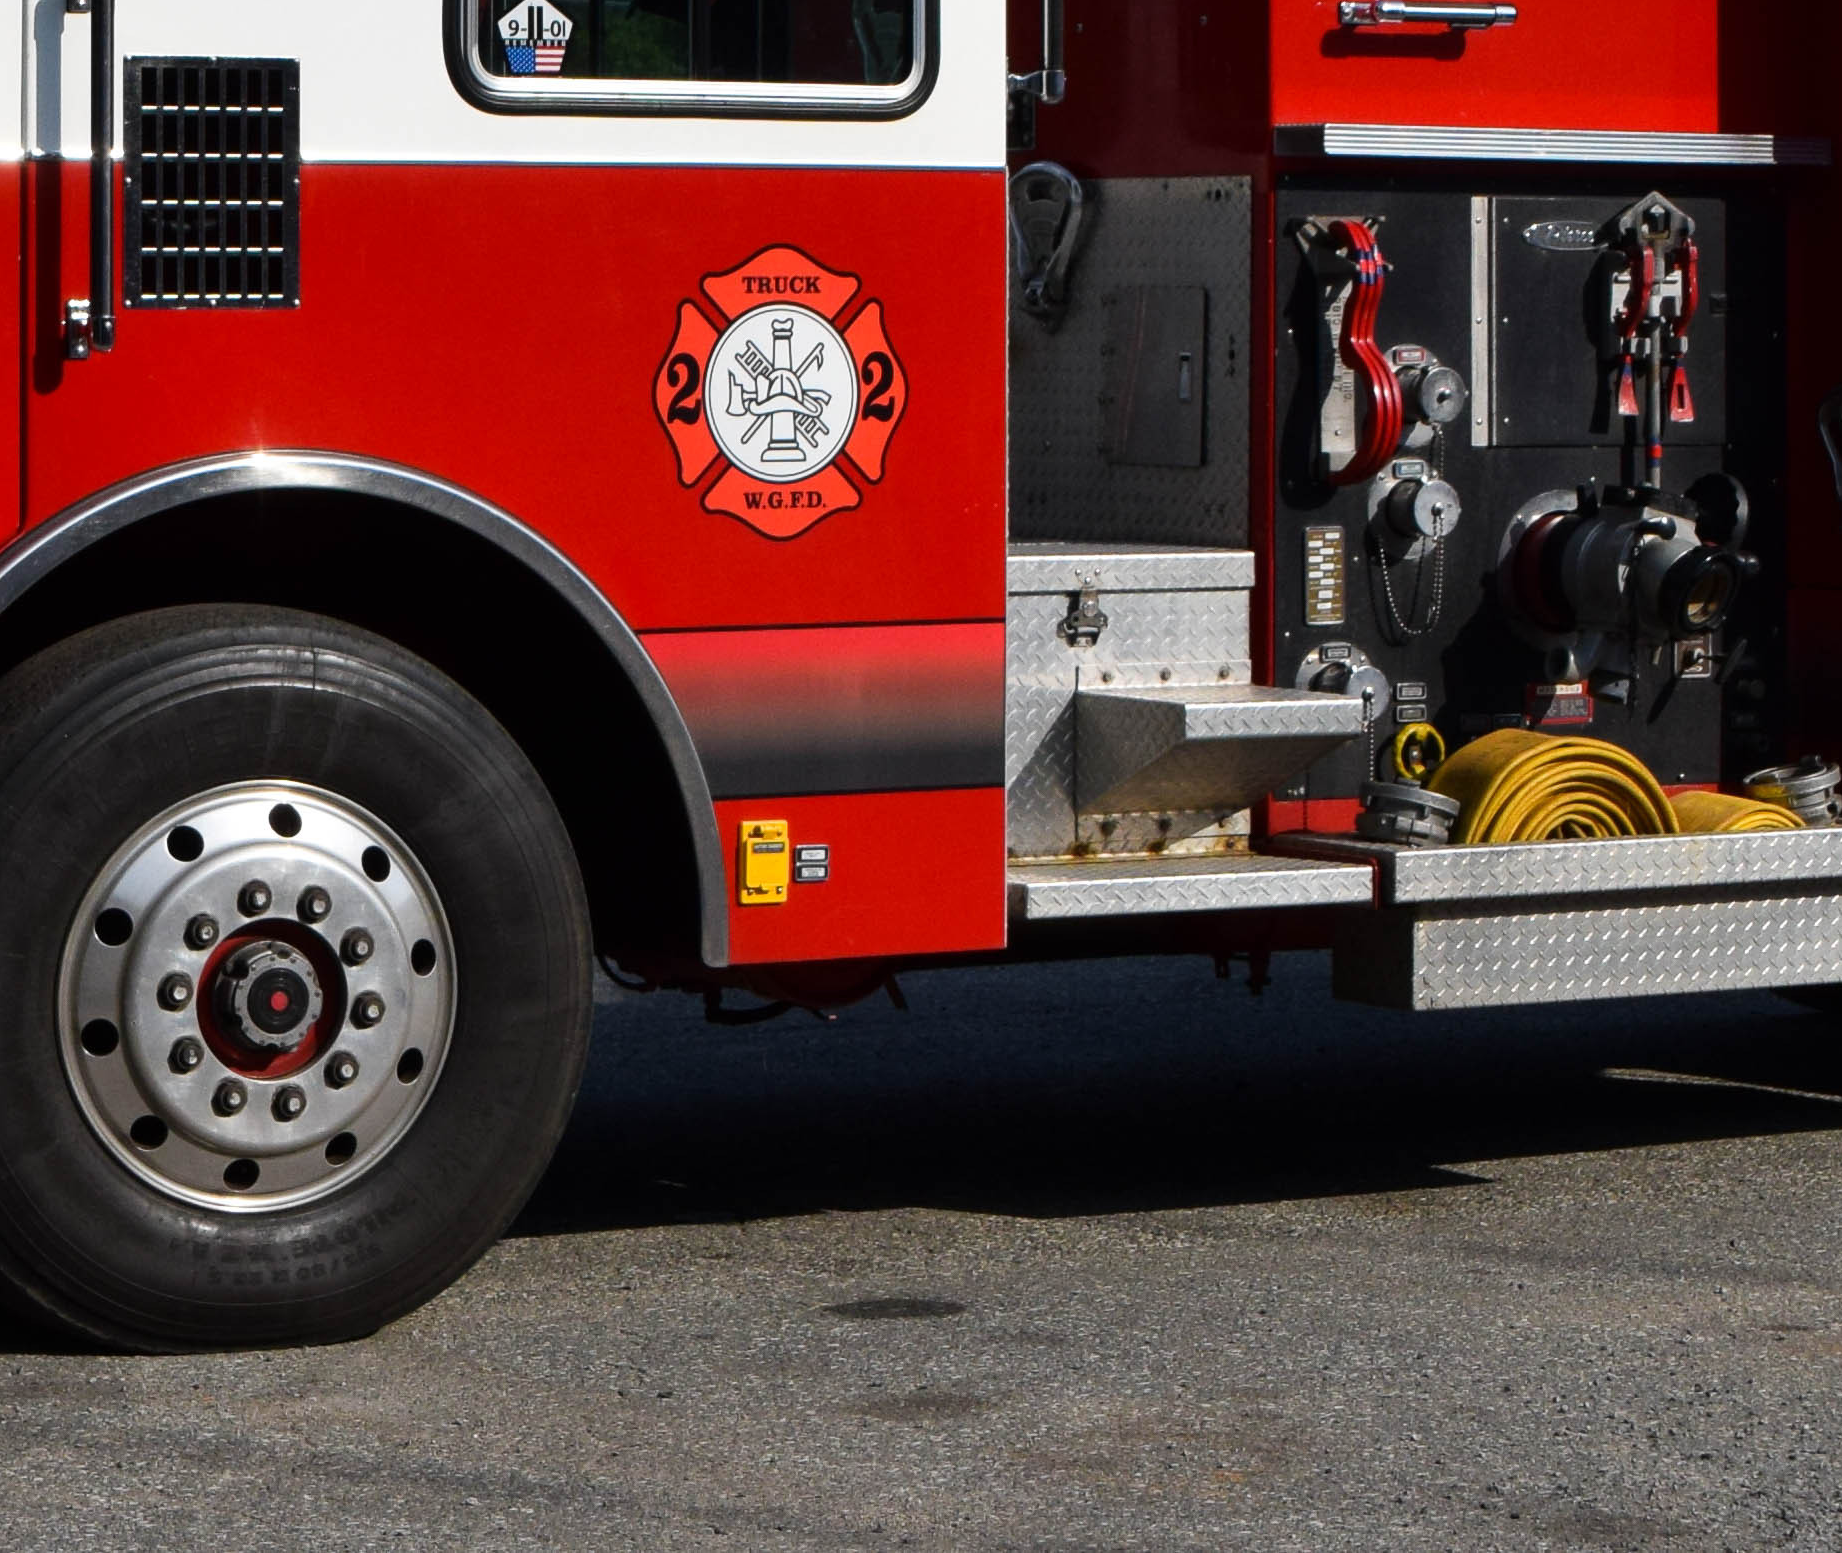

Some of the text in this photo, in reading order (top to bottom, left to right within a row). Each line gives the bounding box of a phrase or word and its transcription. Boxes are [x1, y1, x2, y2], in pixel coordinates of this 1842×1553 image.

[742, 275, 822, 295] TRUCK
[666, 352, 702, 425] 2
[861, 351, 896, 423] 2
[743, 490, 827, 510] W.G.F.D.
